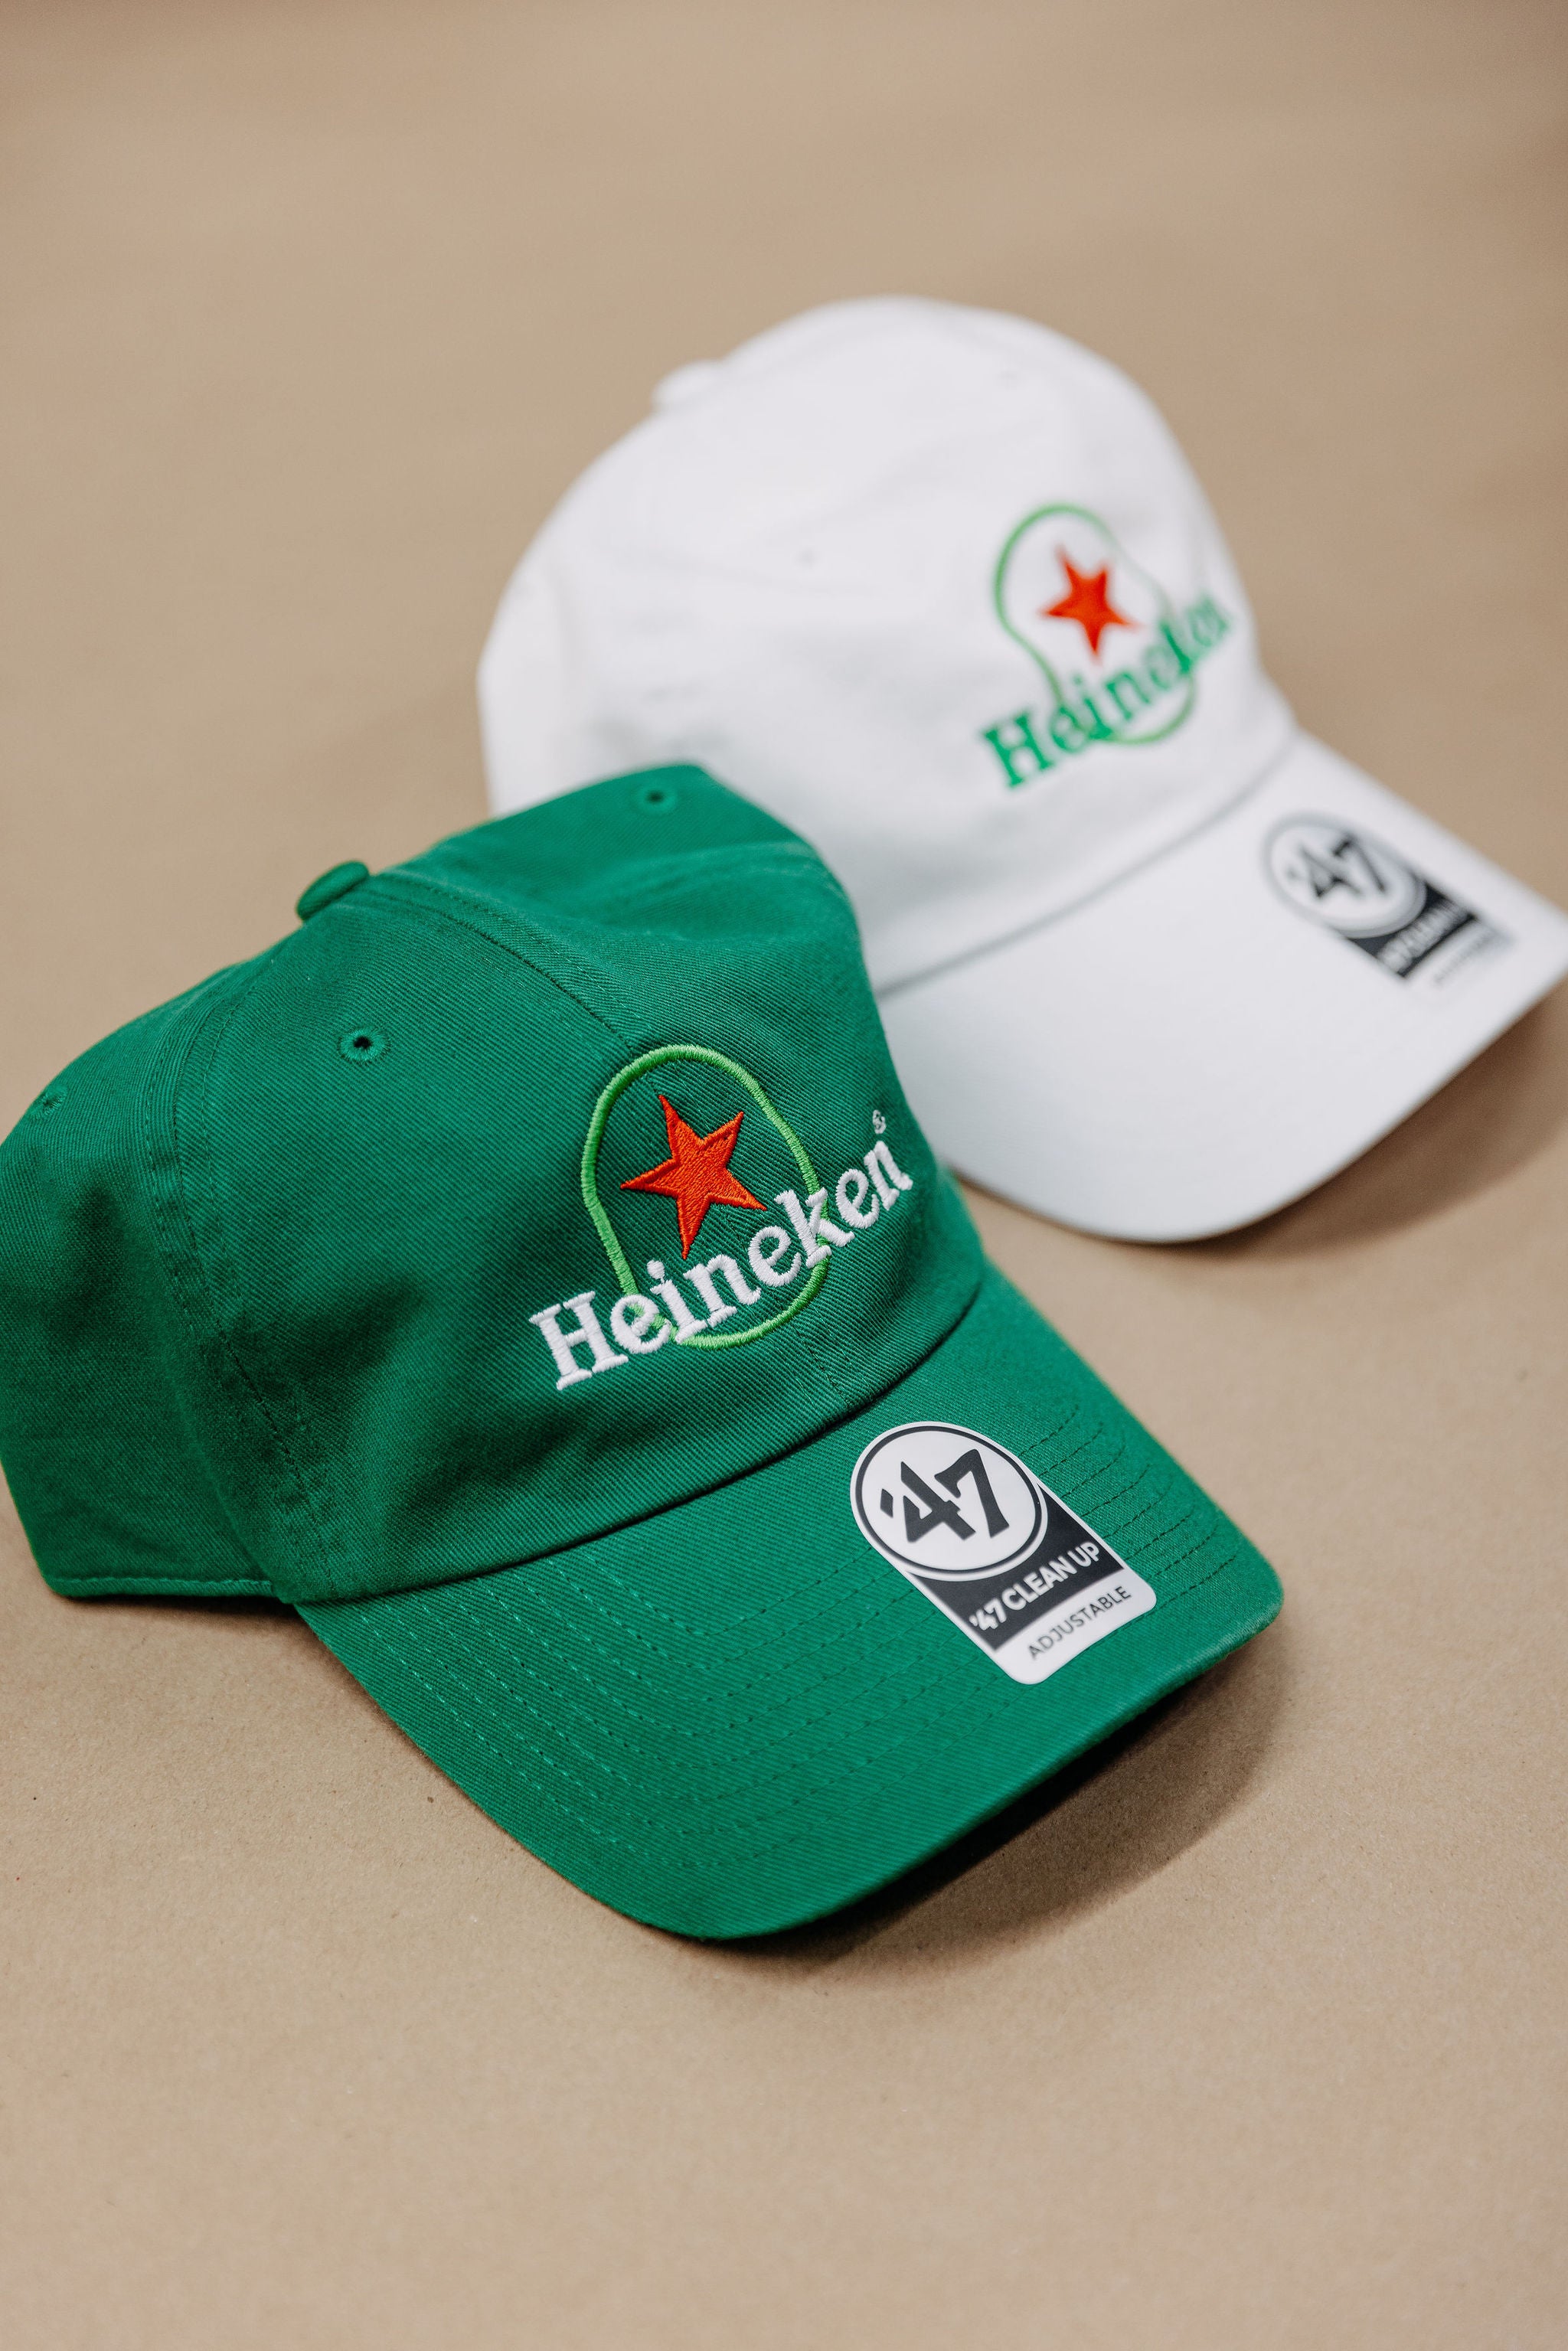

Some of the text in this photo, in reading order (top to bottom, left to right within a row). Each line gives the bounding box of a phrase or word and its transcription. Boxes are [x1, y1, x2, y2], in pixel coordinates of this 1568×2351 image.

[529, 1139, 914, 1390] Heineken
[880, 1449, 1010, 1544] '47
[969, 1542, 1099, 1631] '47 CLEAN UP
[1027, 1585, 1132, 1660] ADJUSTABLE
